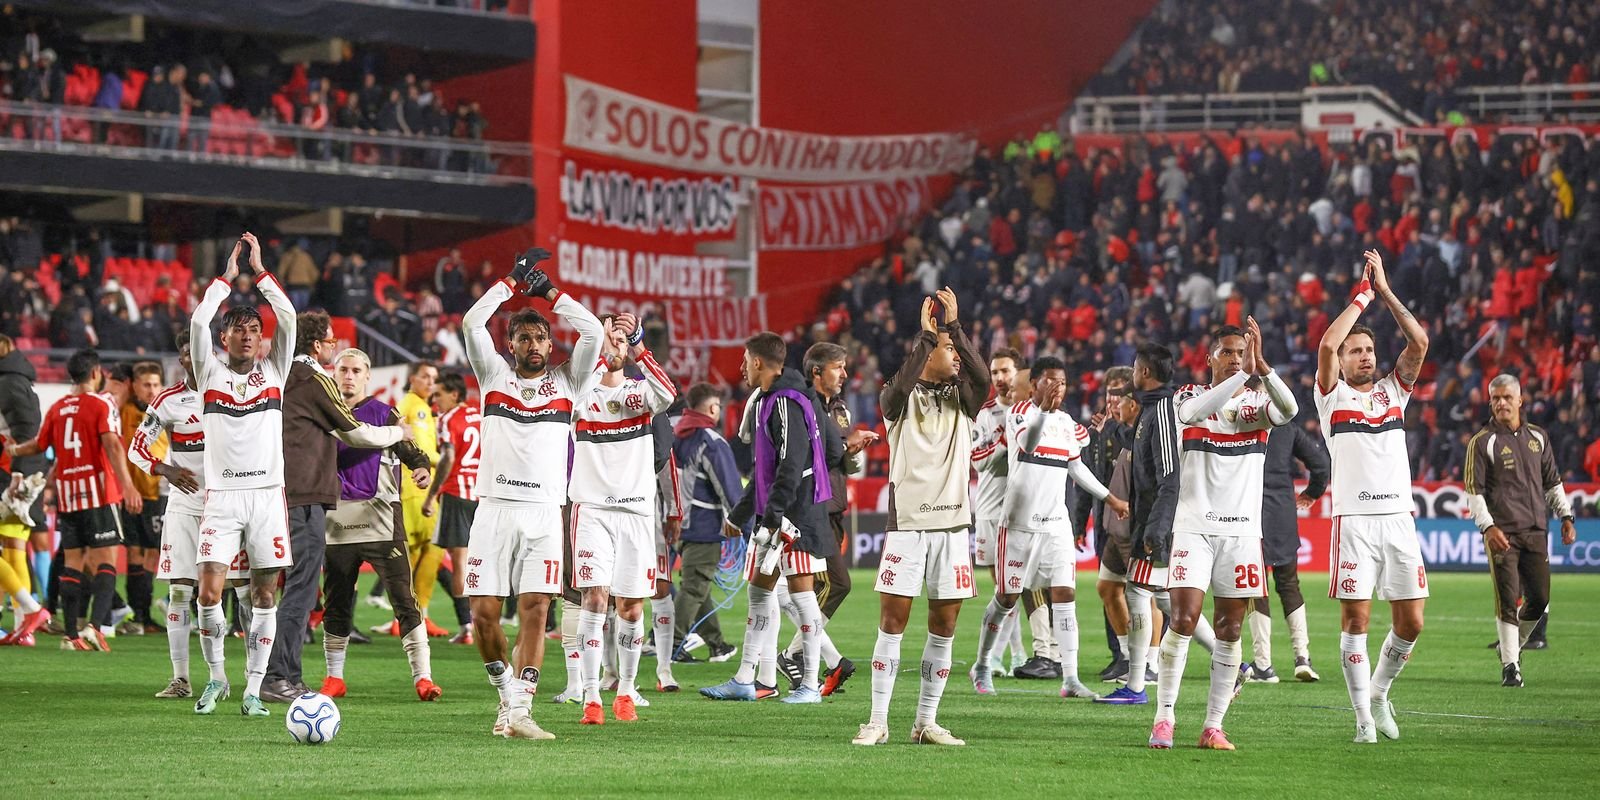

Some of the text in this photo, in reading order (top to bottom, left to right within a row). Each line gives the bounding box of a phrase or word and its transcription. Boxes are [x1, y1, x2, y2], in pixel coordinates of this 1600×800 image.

[605, 101, 711, 160] SOLOS
[718, 124, 840, 171] CONTRA
[561, 161, 735, 235] LA VIDA POR VOS
[558, 240, 727, 297] GLORIA O MUERTE
[63, 416, 82, 458] 4
[461, 426, 480, 466] 2
[234, 469, 267, 479] ADEMICON
[506, 479, 541, 489] ADEMICON
[617, 496, 646, 504] ADEMICON
[931, 503, 962, 512] ADEMICON
[1372, 493, 1400, 501] ADEMICON
[343, 522, 370, 530] ADEMICON
[273, 536, 286, 559] 5
[578, 550, 594, 559] Wap
[885, 552, 902, 565] Wap
[543, 559, 560, 585] 11
[1008, 559, 1024, 569] Wap
[1340, 561, 1358, 572] Wap
[646, 568, 656, 590] 4
[953, 564, 971, 590] 16
[1234, 563, 1260, 589] 26
[1417, 565, 1426, 589] 8
